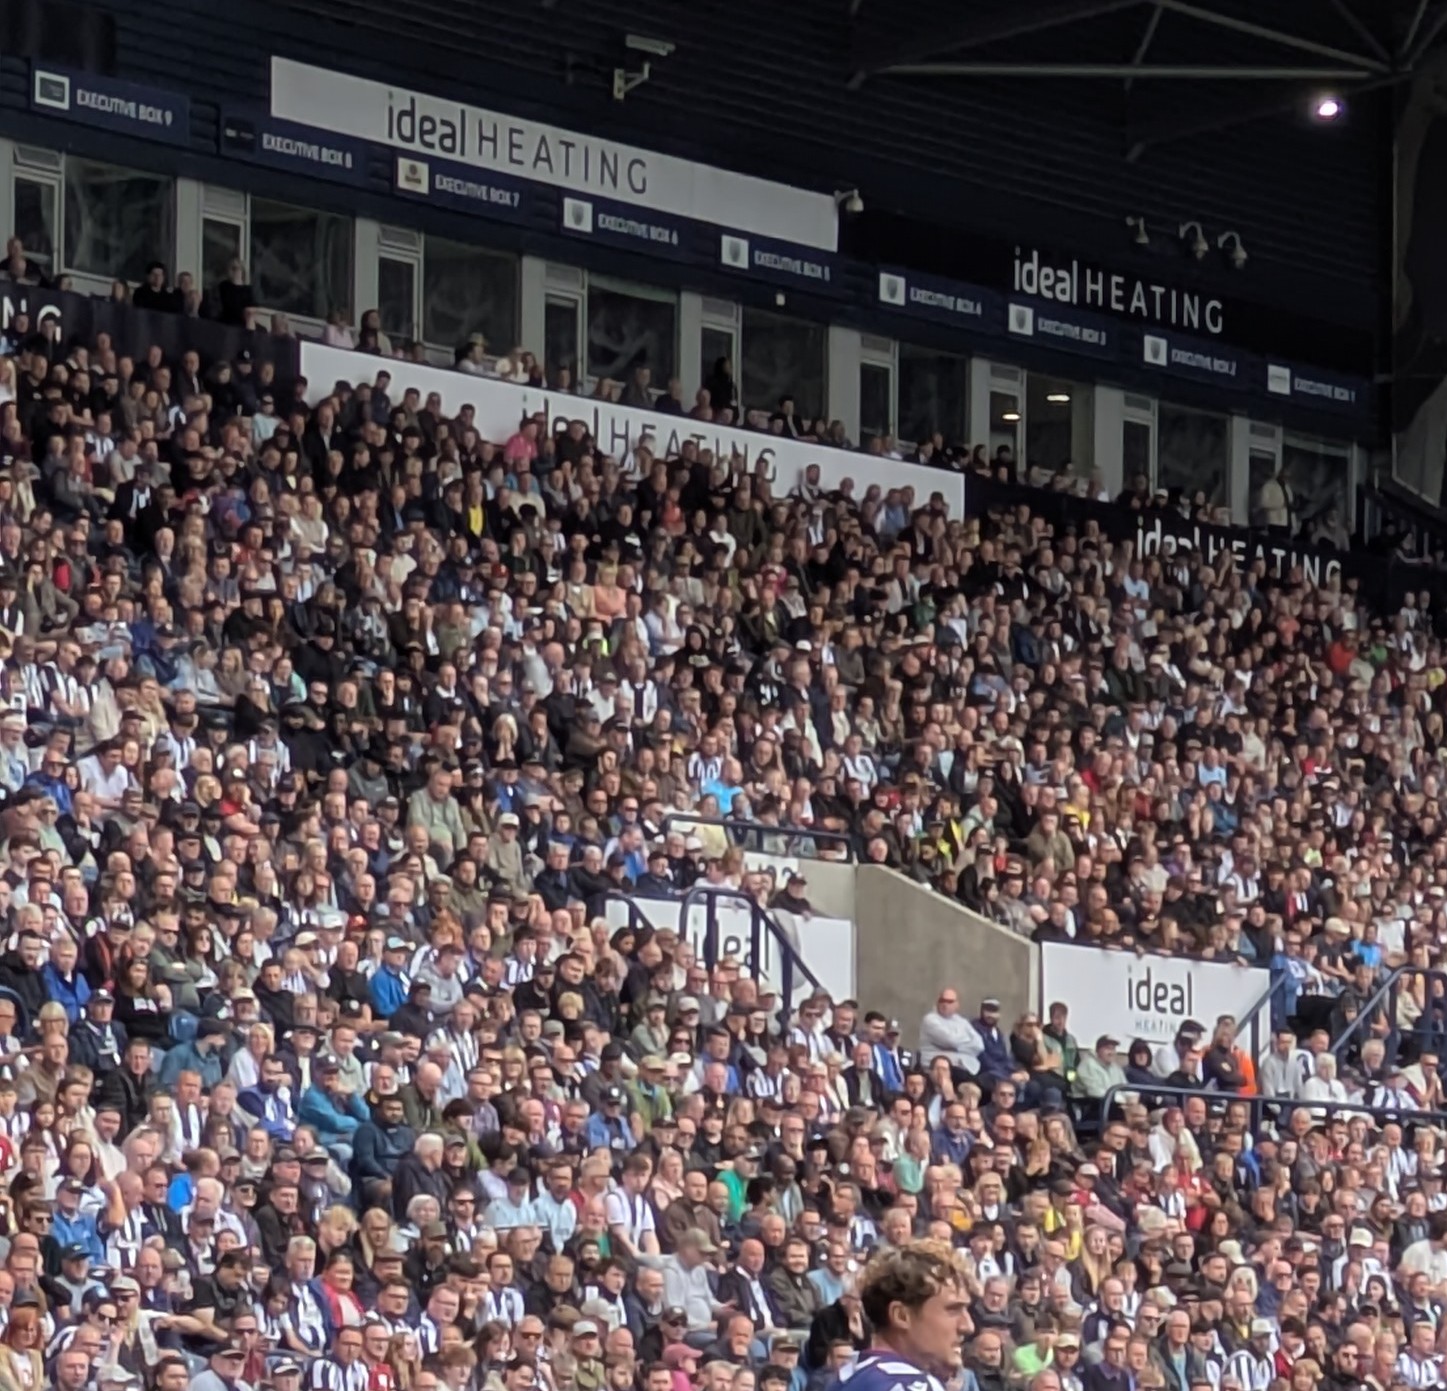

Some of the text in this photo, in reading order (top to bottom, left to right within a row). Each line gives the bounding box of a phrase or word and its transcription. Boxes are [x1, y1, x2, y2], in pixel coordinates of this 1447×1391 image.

[77, 88, 137, 118] EXECUTIVE
[138, 103, 164, 125] BOX
[164, 110, 173, 127] 9
[262, 132, 320, 161] EXECUTIVE
[321, 147, 344, 166] BOX
[387, 90, 648, 195] ideal HEATING
[434, 174, 488, 201] EXECUTIVE
[489, 187, 512, 206] BOX
[512, 191, 520, 208] 7
[598, 213, 649, 239] EXECUTIVE
[650, 225, 670, 243] BOX
[1013, 245, 1223, 334] ideal HEATING
[1128, 964, 1193, 1016] ideal
[1135, 1019, 1178, 1034] HEATIN
